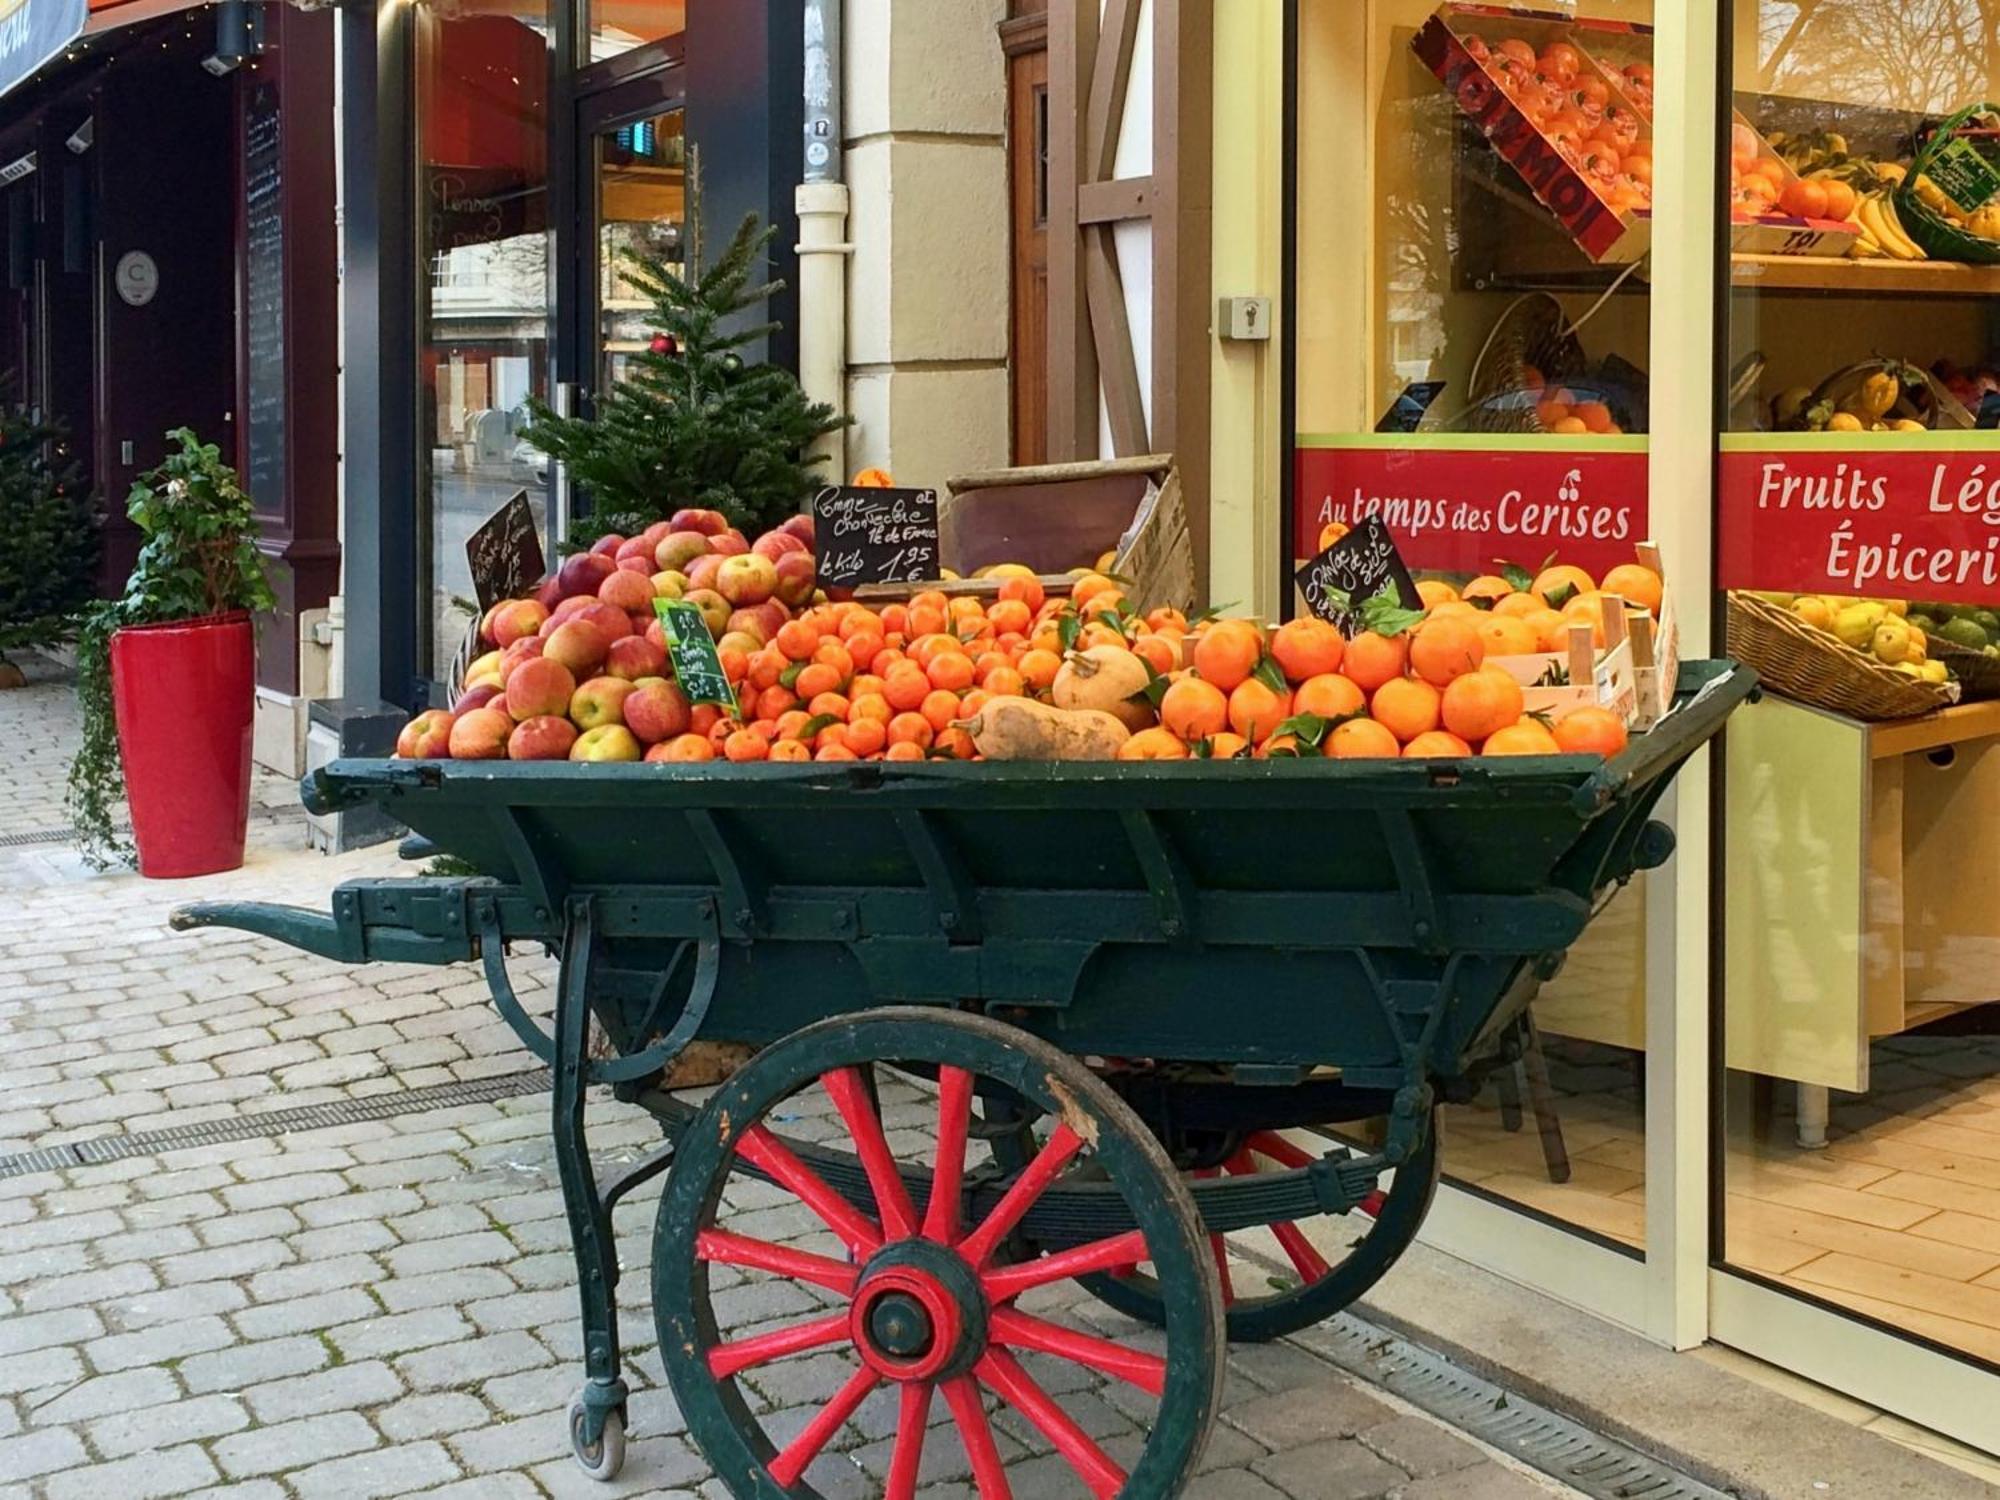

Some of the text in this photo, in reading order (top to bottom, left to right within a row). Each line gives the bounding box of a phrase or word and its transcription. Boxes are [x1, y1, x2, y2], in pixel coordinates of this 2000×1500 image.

[1758, 463, 1888, 511] Fruits
[1317, 488, 1631, 540] Au temps des Cerises
[1826, 519, 2000, 589] Épiceri
